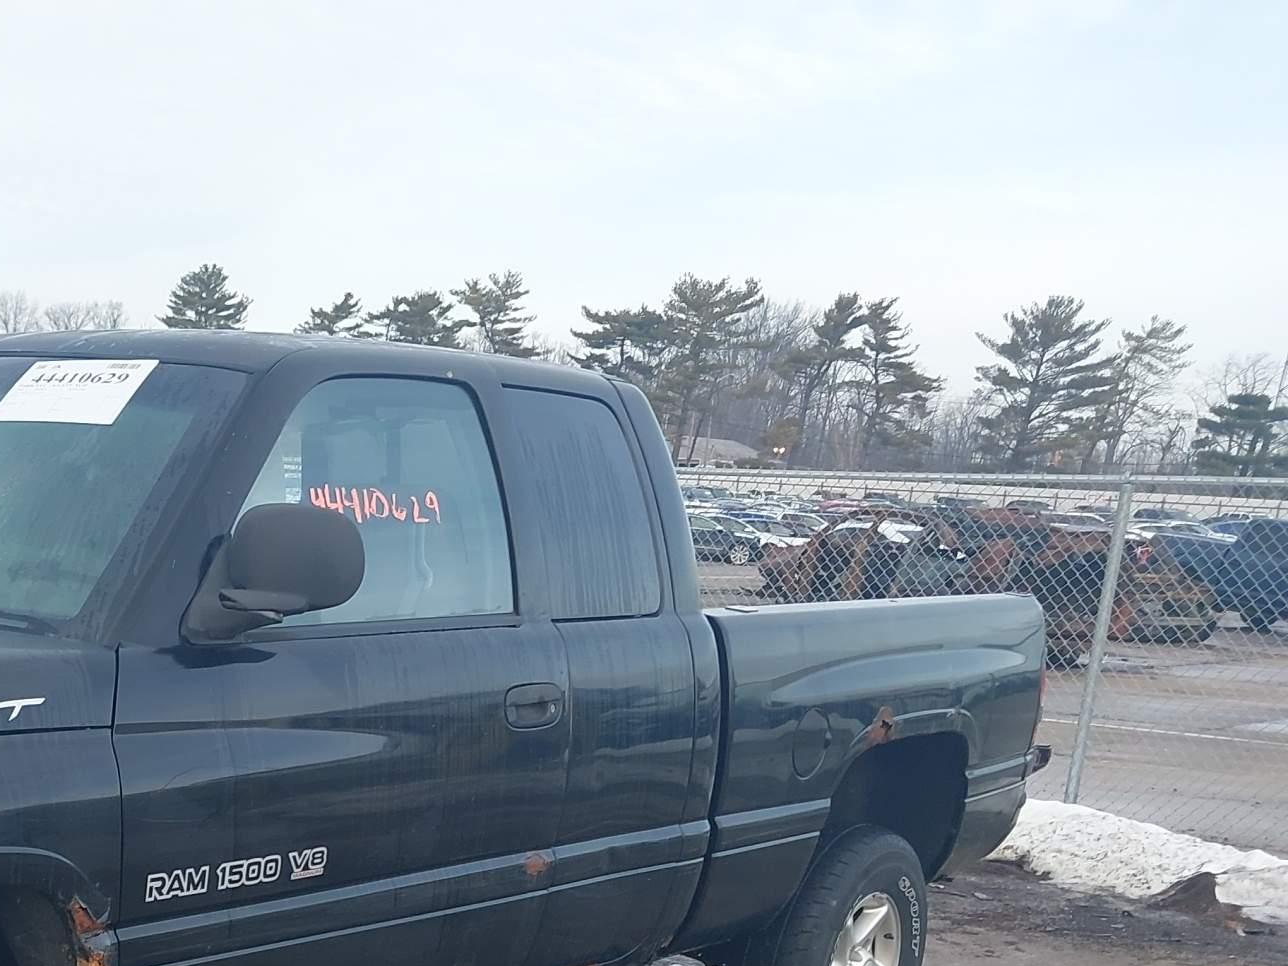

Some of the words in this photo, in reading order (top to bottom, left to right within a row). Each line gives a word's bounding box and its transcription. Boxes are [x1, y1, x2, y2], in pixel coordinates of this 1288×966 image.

[31, 372, 130, 385] 44410629
[145, 865, 210, 902] RAM
[216, 855, 282, 890] 1500
[288, 847, 328, 873] V8
[897, 875, 920, 957] SPORT
